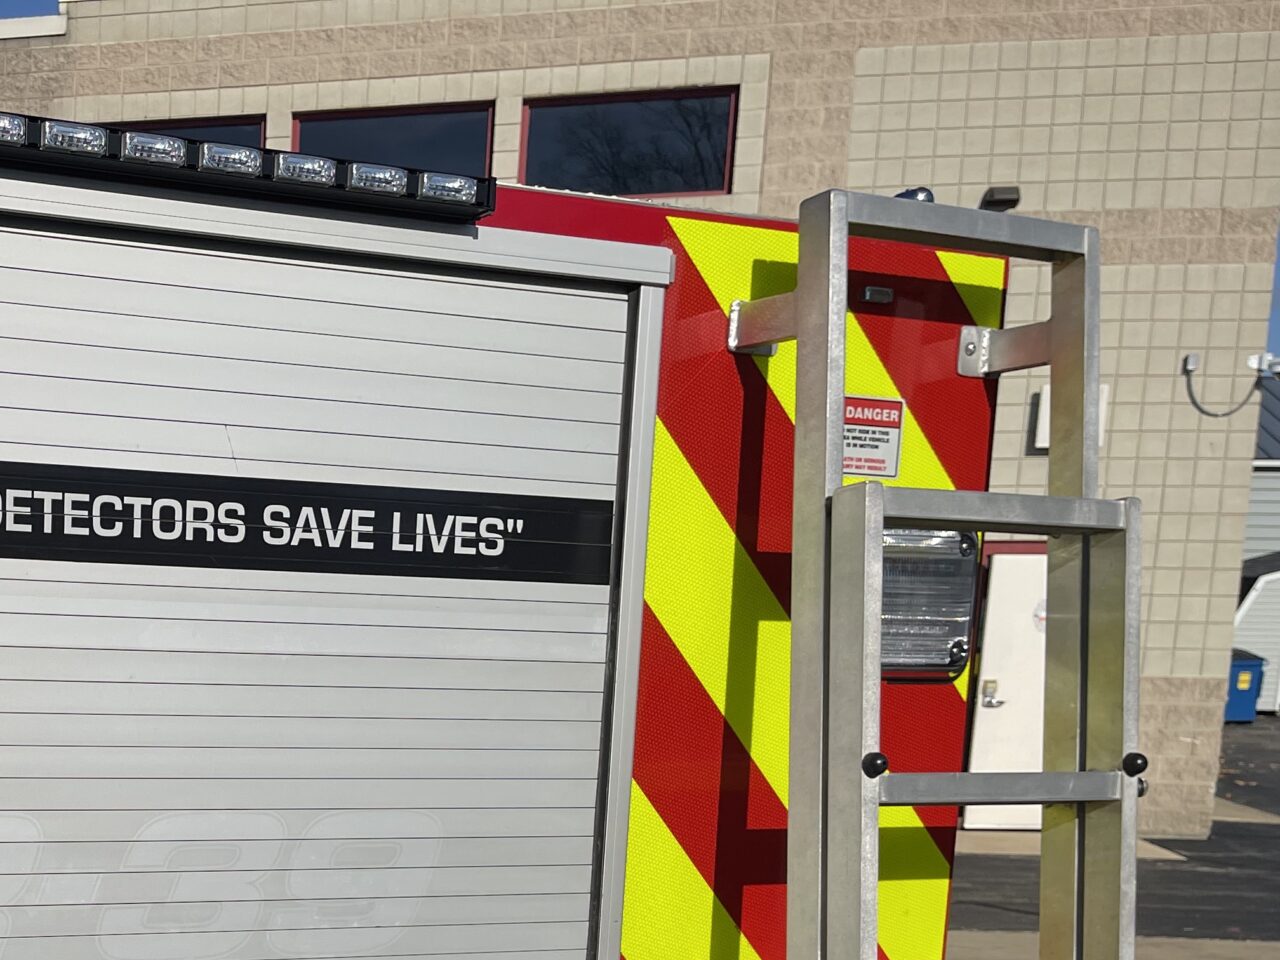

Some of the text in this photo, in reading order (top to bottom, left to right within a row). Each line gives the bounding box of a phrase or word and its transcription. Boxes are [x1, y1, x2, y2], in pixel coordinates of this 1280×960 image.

[845, 406, 899, 422] DANGER
[262, 504, 375, 550] SAVE
[391, 512, 523, 557] LIVES"
